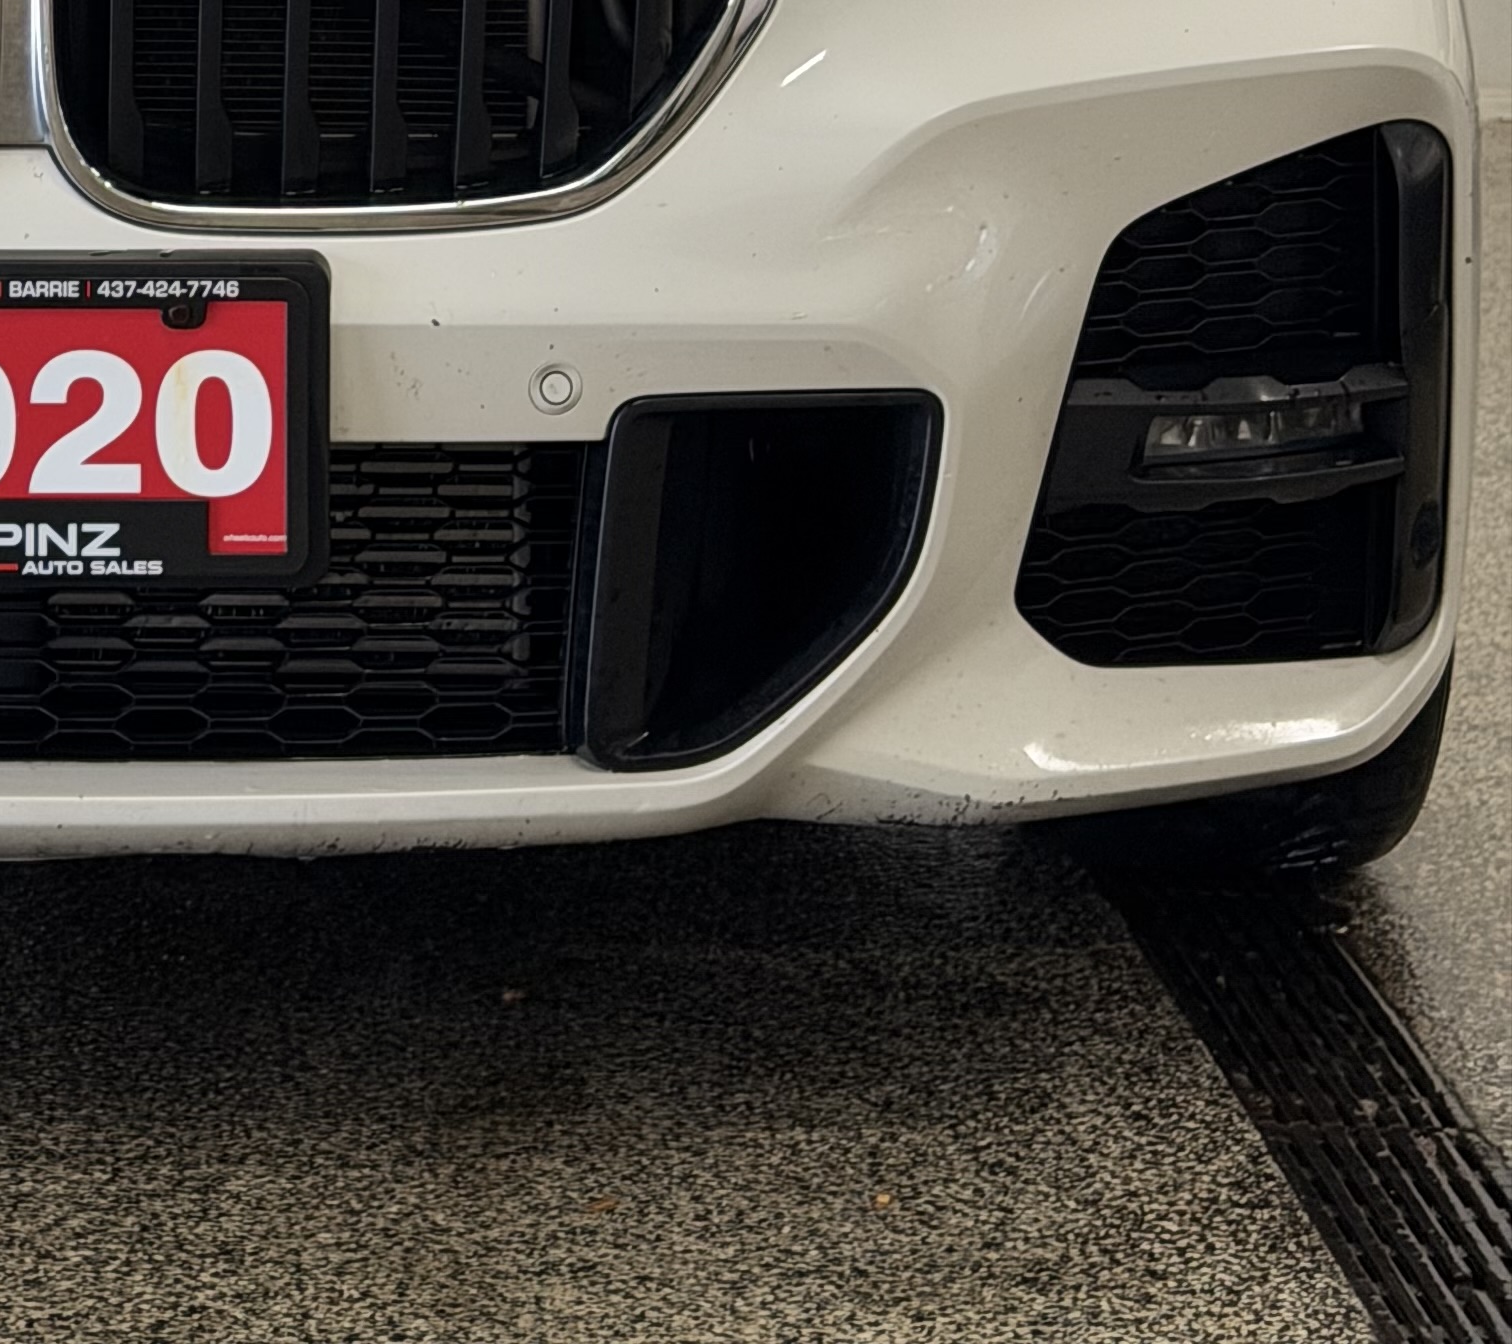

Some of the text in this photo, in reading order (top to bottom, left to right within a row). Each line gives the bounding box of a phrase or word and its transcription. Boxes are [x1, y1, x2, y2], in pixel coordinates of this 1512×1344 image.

[9, 280, 80, 298] BARRIE
[96, 280, 240, 298] 437-424-7746
[21, 560, 164, 575] AUTO SALES
